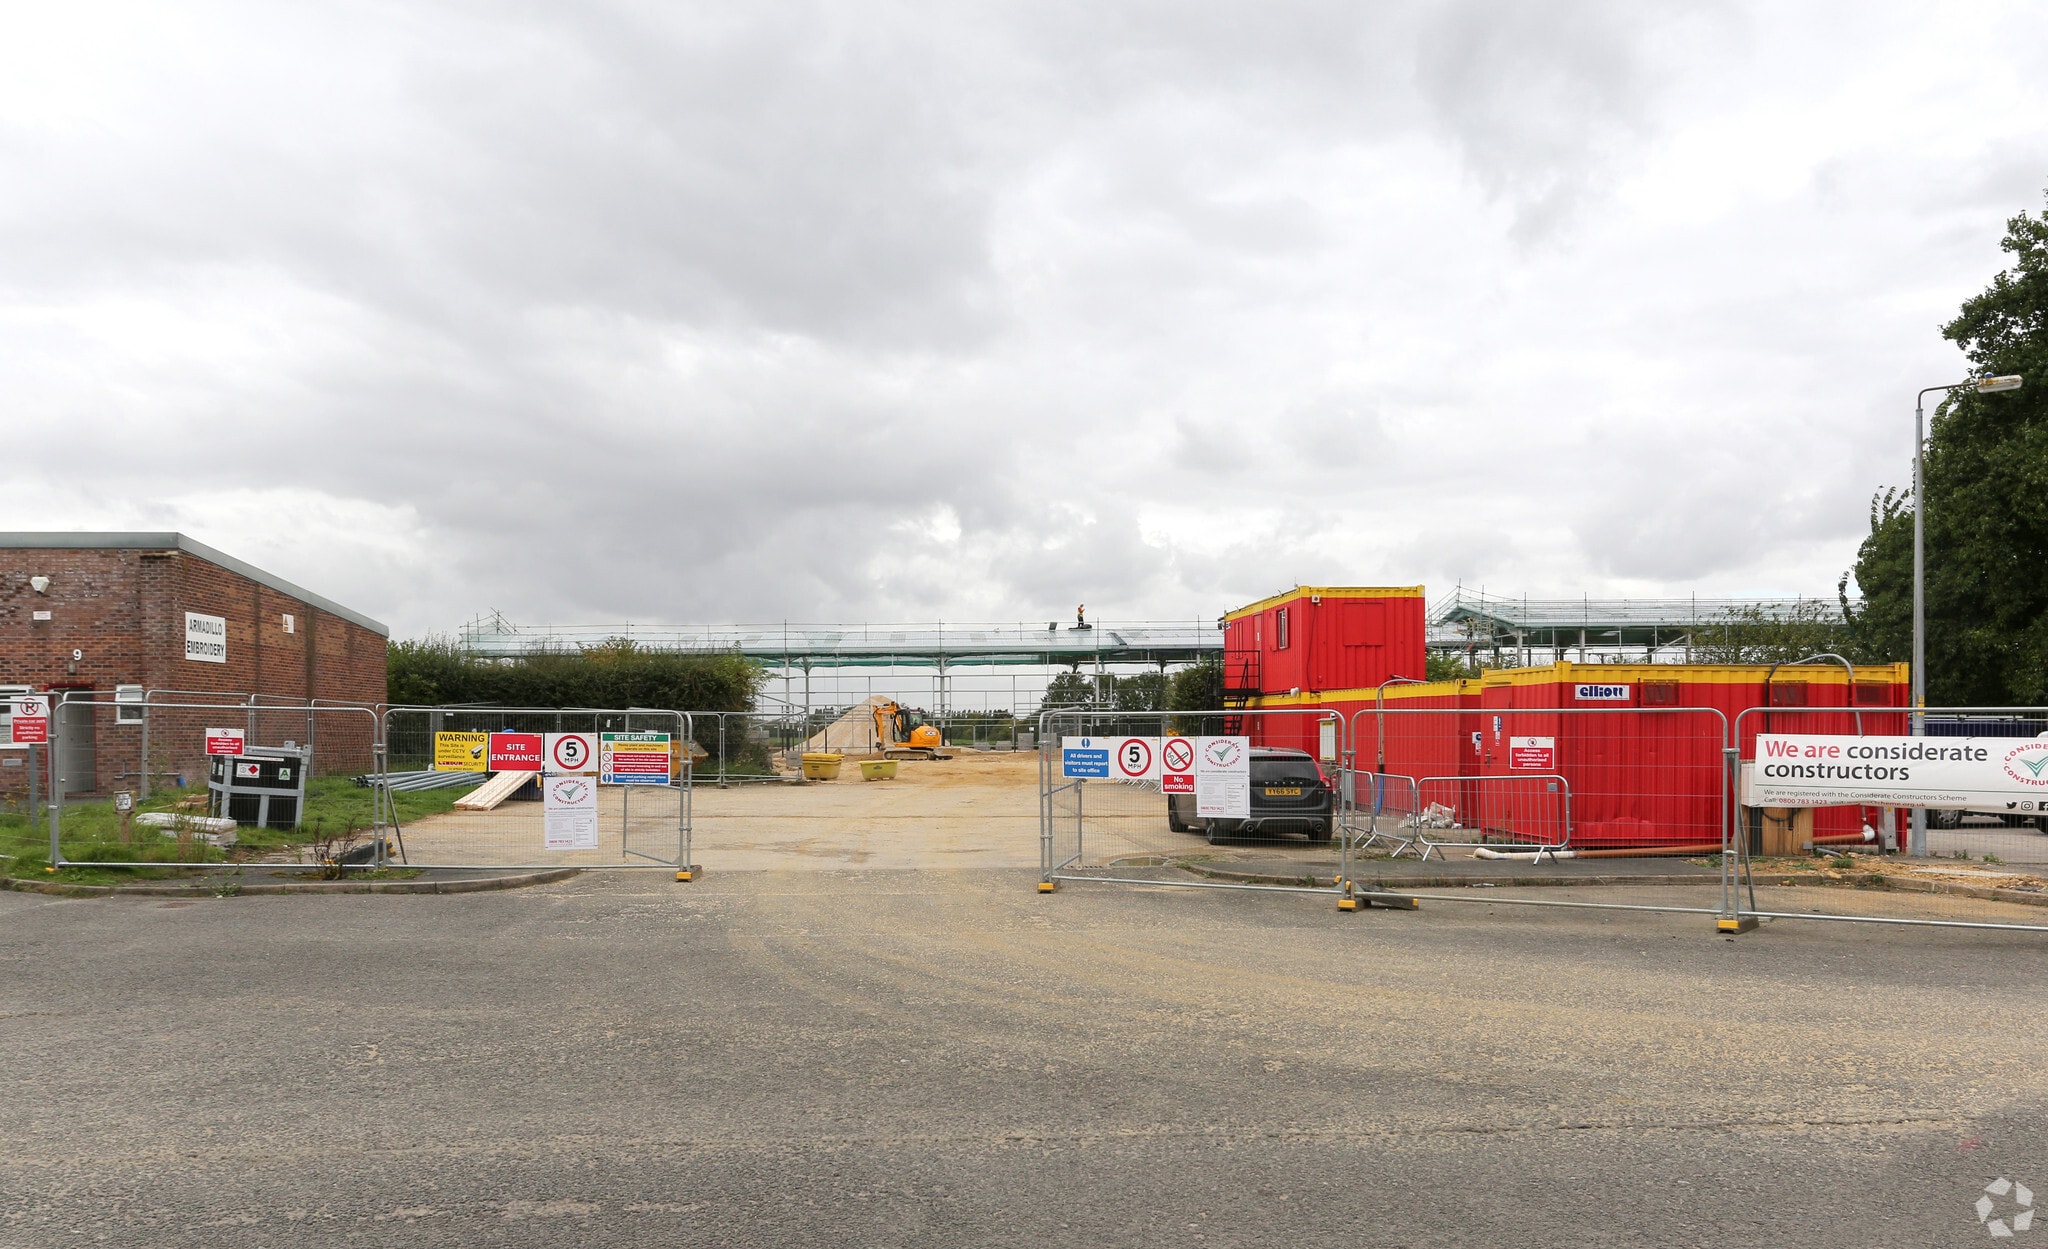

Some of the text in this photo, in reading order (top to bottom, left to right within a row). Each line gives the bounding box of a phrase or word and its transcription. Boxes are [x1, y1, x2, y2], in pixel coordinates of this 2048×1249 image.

[189, 619, 222, 635] ARMADILLO
[73, 649, 82, 660] 9
[187, 640, 224, 656] EMBROIDERY
[439, 734, 484, 742] WARNING
[566, 742, 577, 757] 5
[1205, 739, 1241, 752] CONSIDERATE
[1765, 740, 1988, 762] We are considerate
[492, 754, 540, 762] ENTRANCE
[1130, 746, 1140, 763] 5
[1205, 754, 1241, 768] CONSTRUCTORS
[1764, 763, 1909, 781] constructors
[2004, 766, 2048, 785] CONSTRU
[553, 779, 588, 792] CONSIDERATE
[1164, 783, 1193, 791] smoking
[553, 793, 588, 805] CONSTRUCTORS
